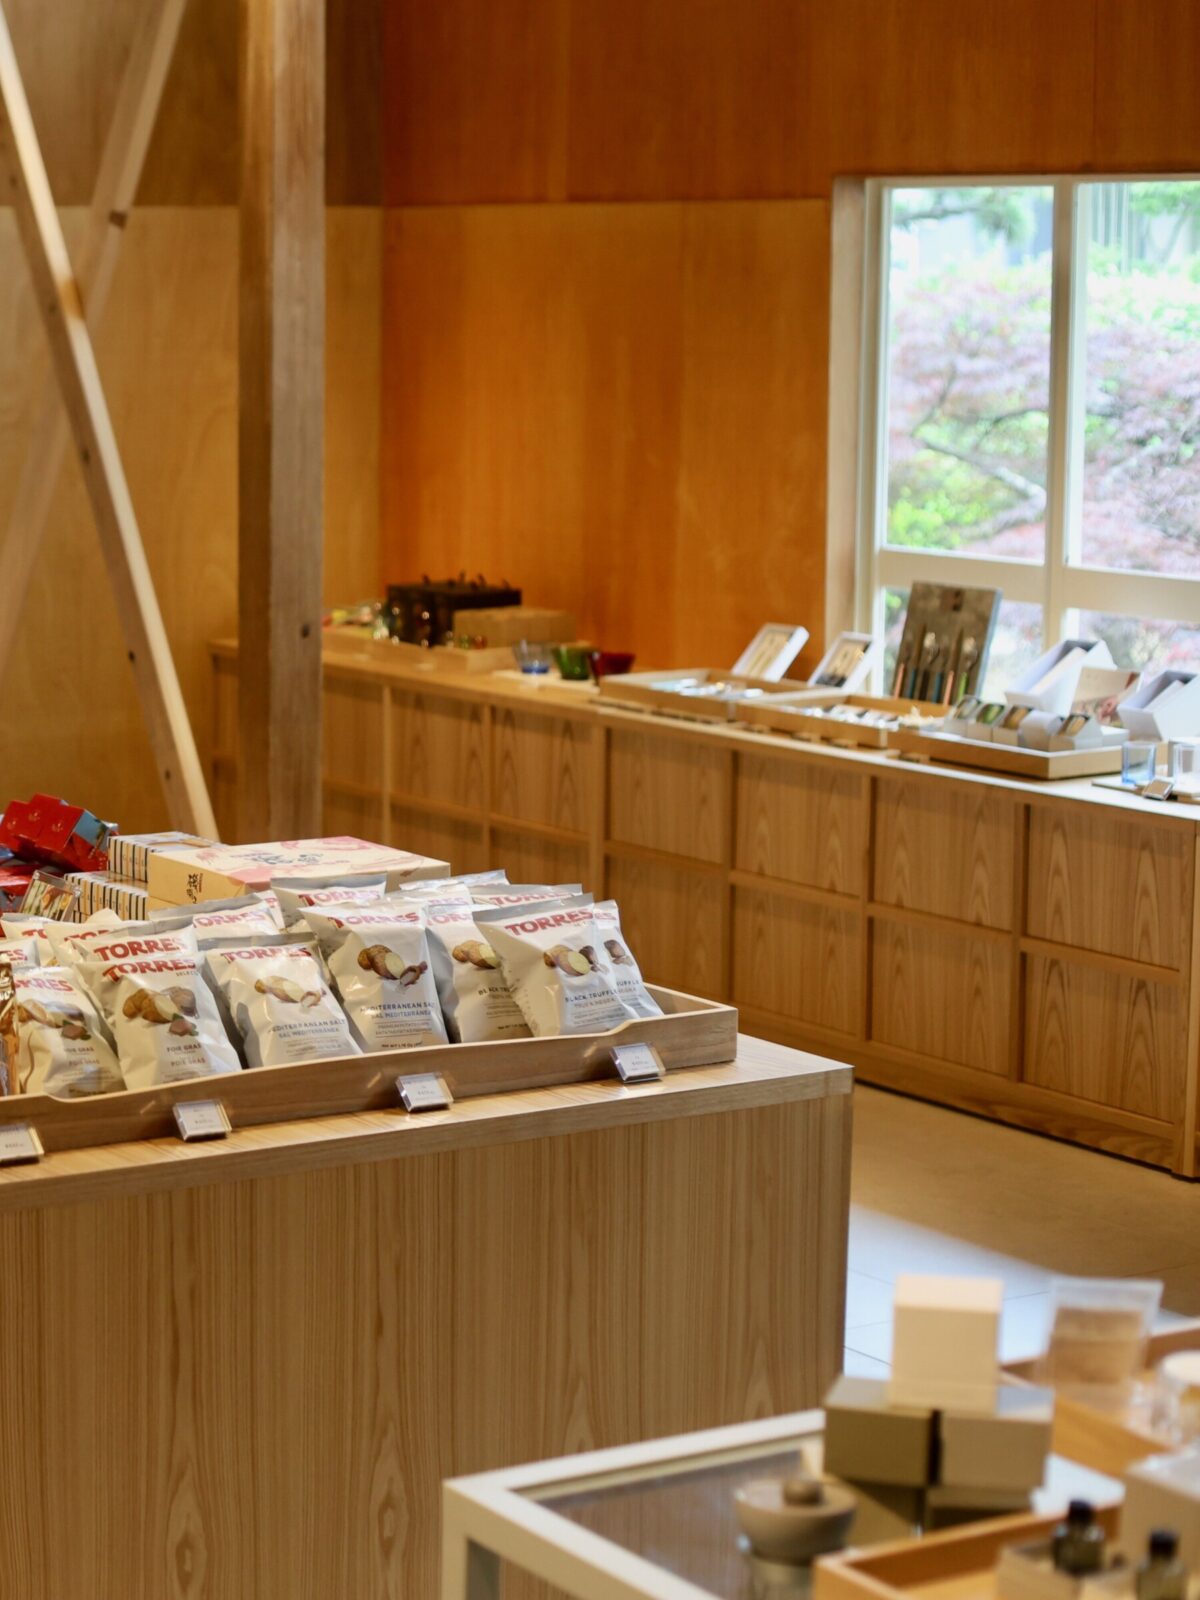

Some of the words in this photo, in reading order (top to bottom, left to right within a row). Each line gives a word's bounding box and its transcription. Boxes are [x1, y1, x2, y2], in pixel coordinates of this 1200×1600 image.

[329, 912, 420, 928] TORRES
[505, 907, 593, 936] TORRES
[94, 938, 186, 961] TORRES
[102, 960, 197, 983] TORRES
[184, 1043, 202, 1051] GRAS
